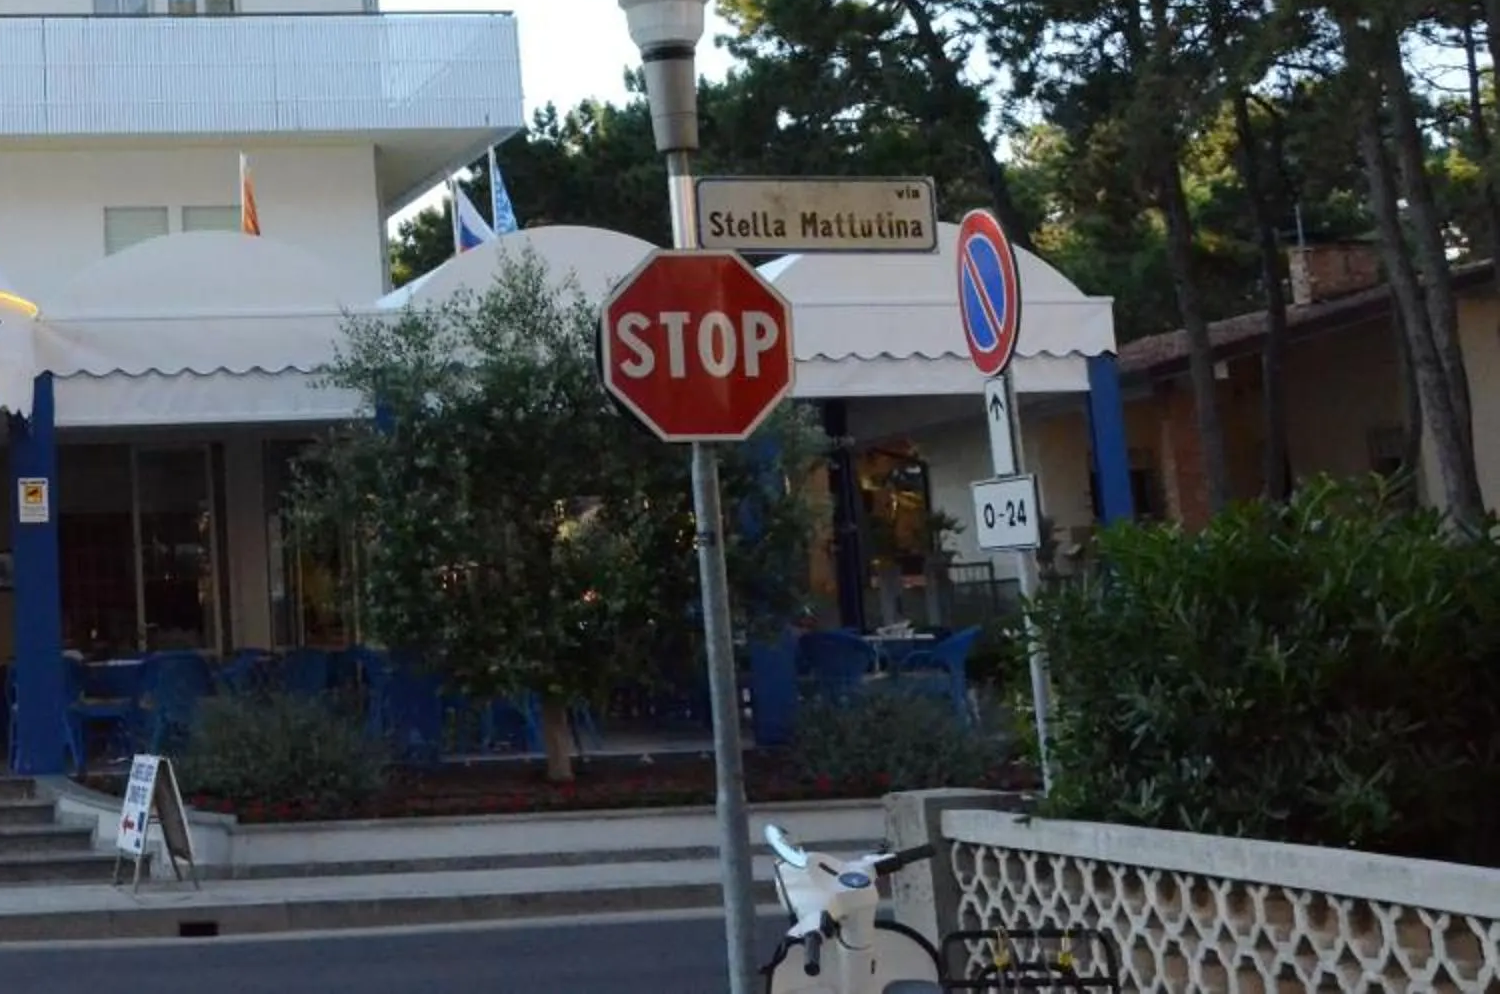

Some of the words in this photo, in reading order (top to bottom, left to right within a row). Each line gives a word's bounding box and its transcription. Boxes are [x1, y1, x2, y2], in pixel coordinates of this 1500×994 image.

[894, 185, 921, 199] via
[708, 211, 787, 239] Stella
[801, 211, 924, 239] Mattutina
[616, 310, 779, 379] STOP
[984, 498, 1027, 529] 0-24
